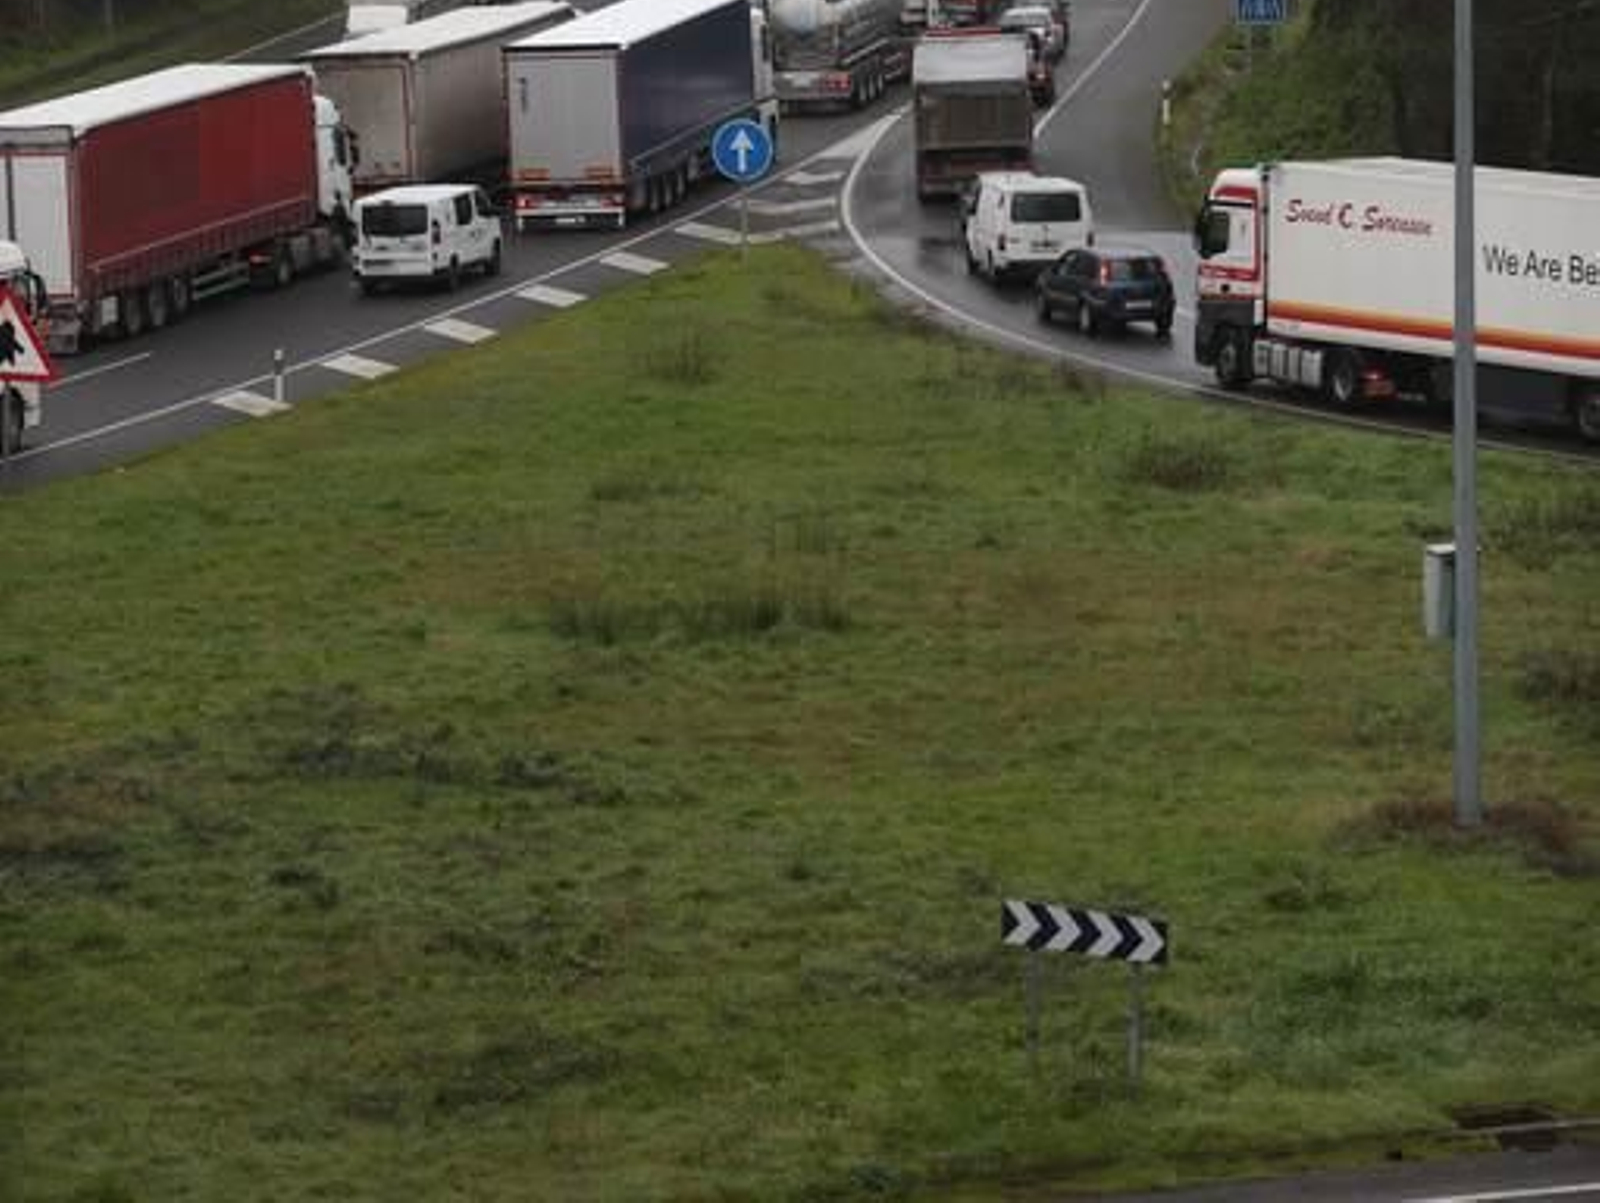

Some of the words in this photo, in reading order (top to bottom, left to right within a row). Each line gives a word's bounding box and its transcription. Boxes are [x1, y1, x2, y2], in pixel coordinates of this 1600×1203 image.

[1481, 244, 1518, 276] We
[1523, 249, 1562, 281] Are
[1569, 254, 1600, 285] Be
